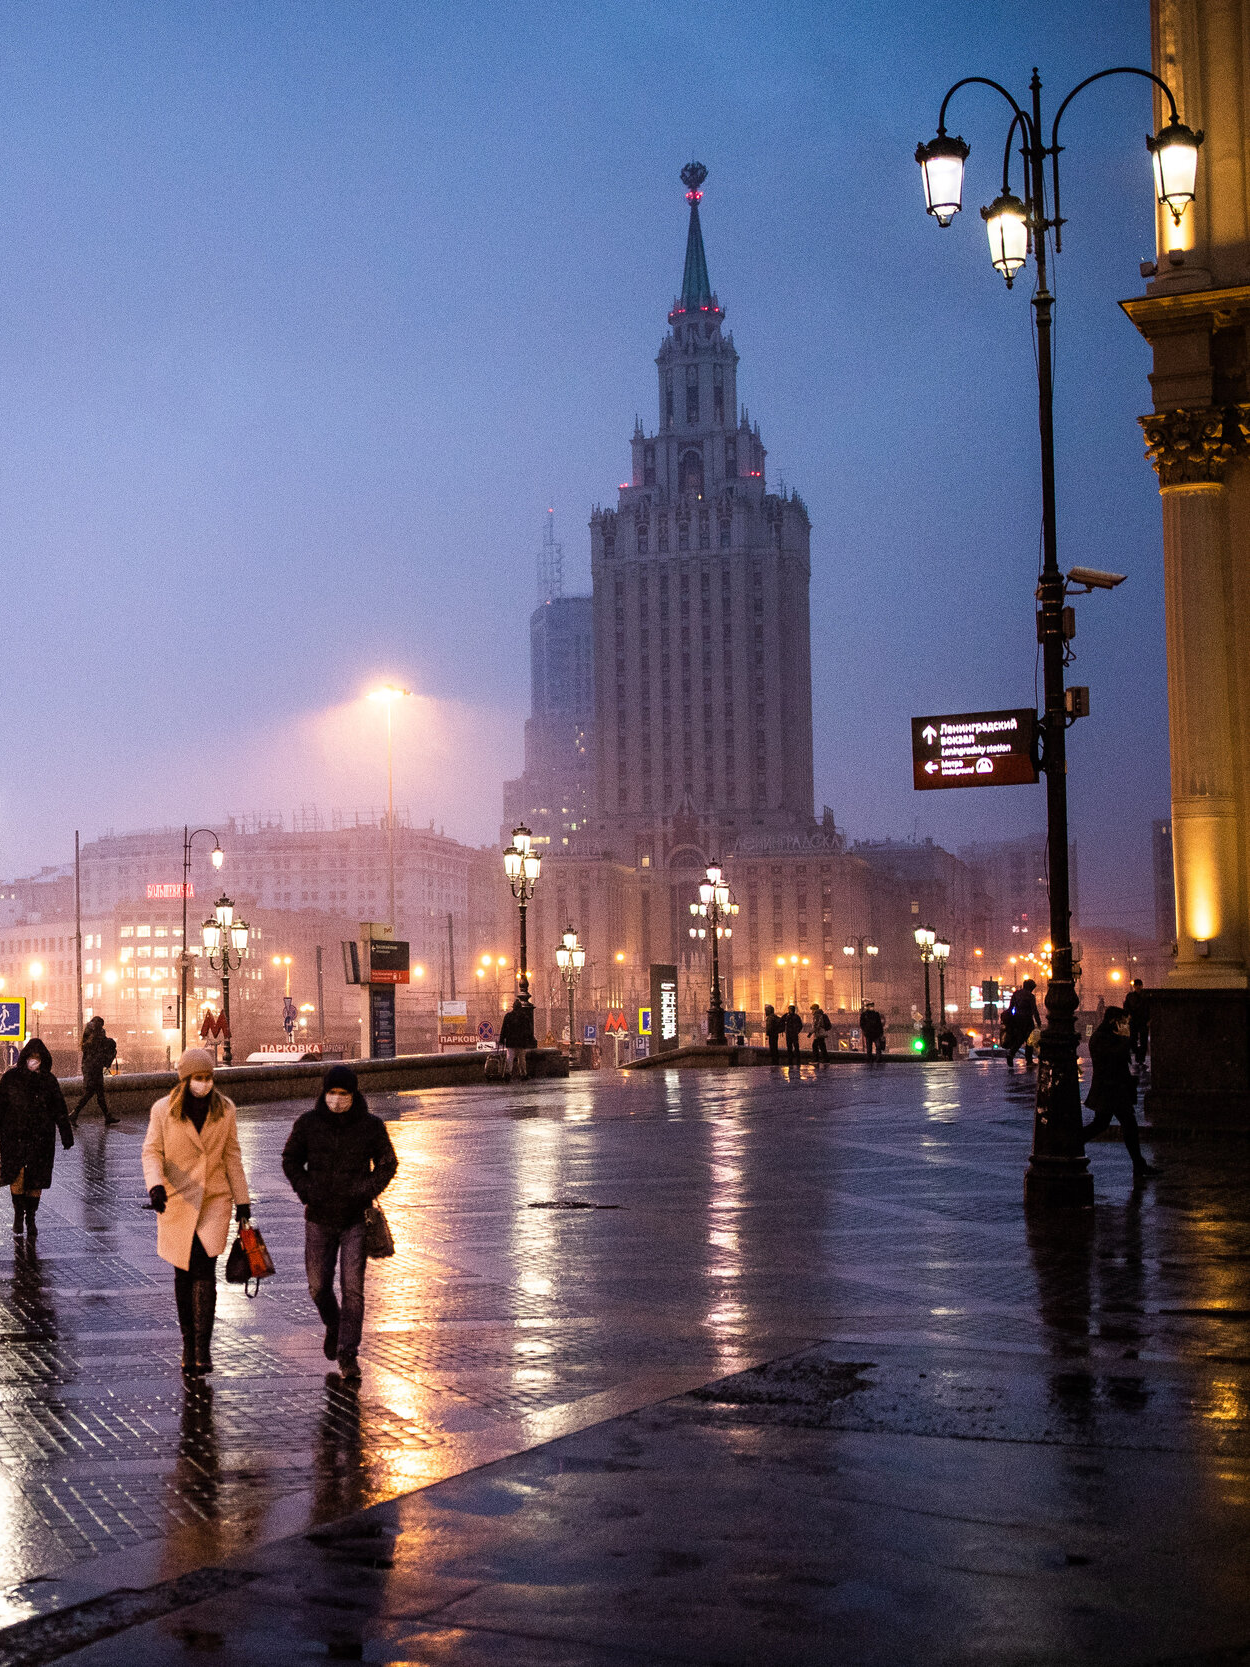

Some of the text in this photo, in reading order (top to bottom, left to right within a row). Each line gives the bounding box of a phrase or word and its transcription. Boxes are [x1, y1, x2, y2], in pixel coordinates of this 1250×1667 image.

[940, 718, 1017, 734] Ленинградский
[941, 735, 974, 745] вокзал
[260, 1044, 320, 1053] ПАРКОВКА
